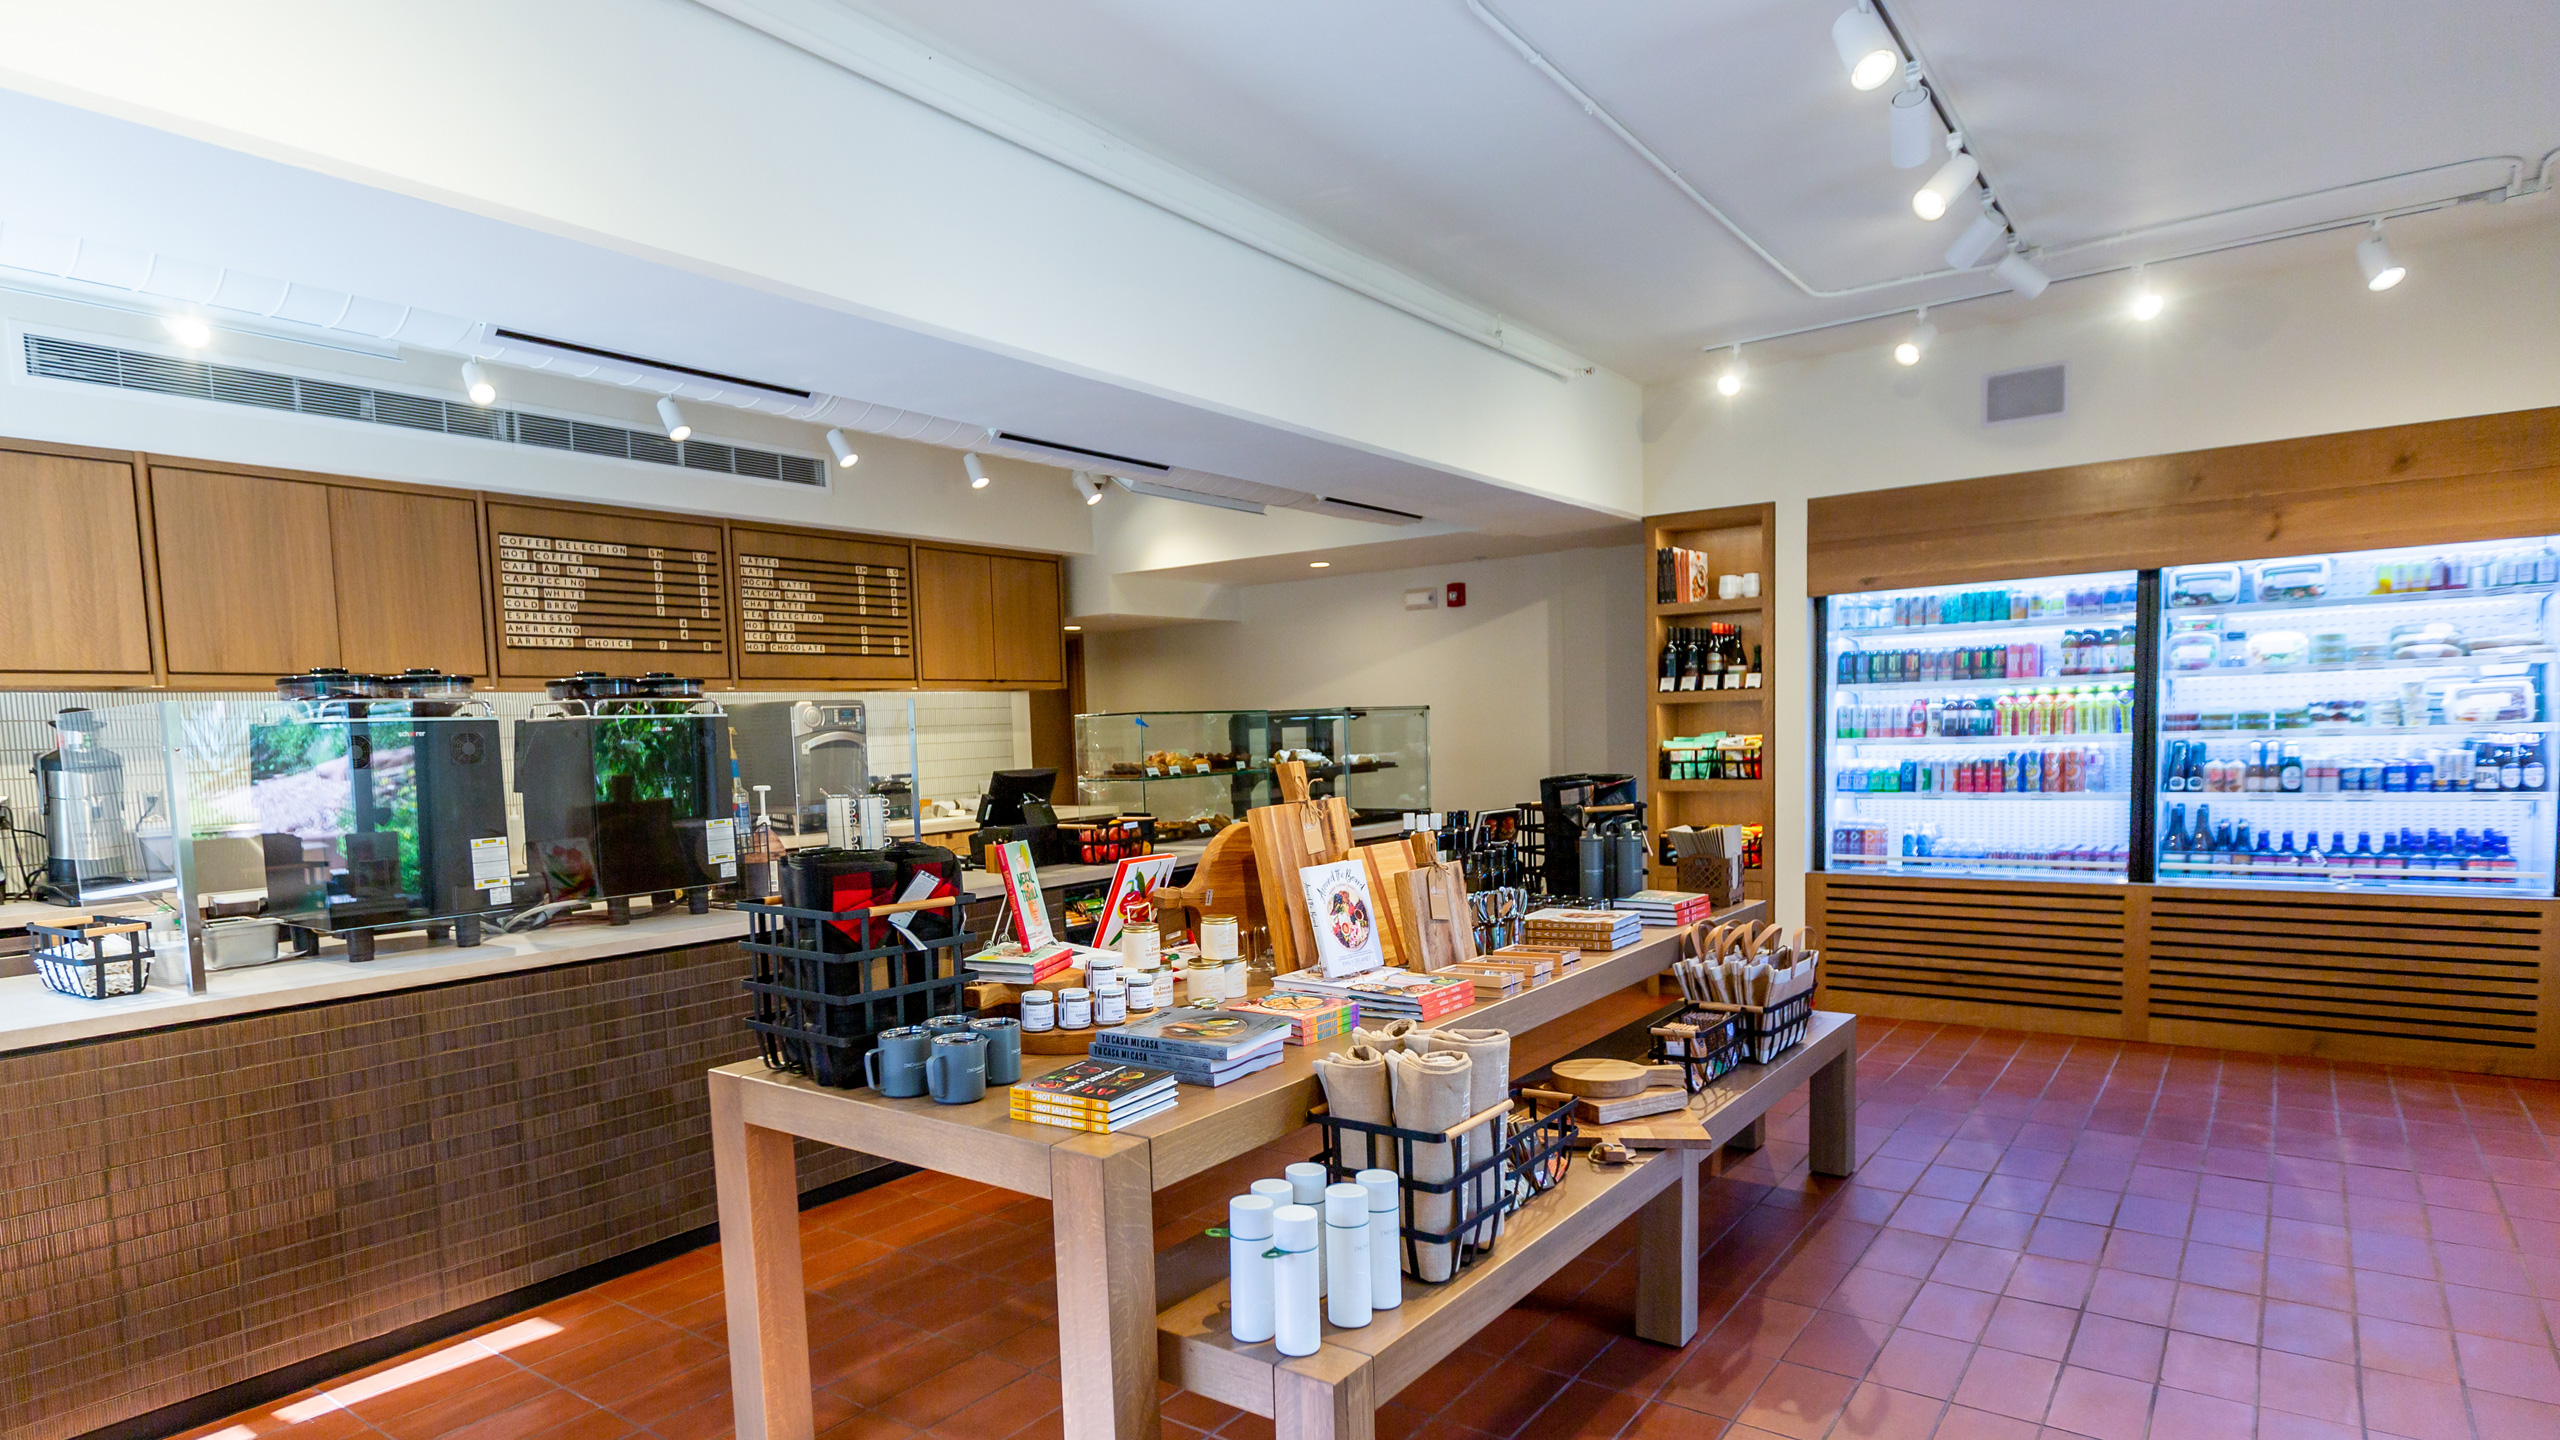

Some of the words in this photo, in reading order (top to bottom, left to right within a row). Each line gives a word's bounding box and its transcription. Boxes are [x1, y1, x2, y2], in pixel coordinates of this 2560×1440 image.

[501, 536, 550, 548] COFFEE
[557, 541, 627, 555] SELECTION
[693, 553, 707, 561] LG
[502, 549, 526, 558] HOT
[534, 552, 581, 563] COFFEE
[741, 557, 778, 566] LATTES
[503, 562, 535, 571] CAFE
[568, 566, 598, 576] LAIT
[742, 567, 772, 576] LATTE
[504, 575, 585, 586] CAPPUCCINO
[657, 584, 662, 592] 7
[742, 579, 774, 587] MOCHA
[780, 581, 809, 589] LATTE
[505, 587, 537, 596] FLAT
[544, 589, 583, 598] WHITE
[742, 589, 781, 598] MATCHA
[786, 592, 814, 600] LATTE
[506, 599, 538, 609] COLD
[546, 601, 577, 610] BREW
[659, 607, 664, 615] 7
[743, 600, 767, 608] CHAI
[775, 602, 803, 610] LATTE
[507, 612, 571, 622] ESPRESSO
[770, 612, 823, 621] SELECTION
[507, 623, 580, 634] AMERICANO
[771, 623, 793, 631] TEAS
[747, 632, 770, 640] ICED
[508, 637, 573, 646] BARISTAS
[587, 639, 631, 647] CHOICE
[661, 641, 666, 649] 7
[771, 644, 824, 652] CHOCOLATE
[1101, 1034, 1110, 1043] TU
[1111, 1035, 1129, 1046] CASA
[1130, 1038, 1139, 1047] MI
[1140, 1039, 1159, 1050] CASA
[1094, 1046, 1102, 1055] TU
[1103, 1047, 1119, 1058] CASA
[1121, 1050, 1130, 1059] MI
[1130, 1051, 1147, 1062] CASA
[1036, 1093, 1051, 1101] HOT
[1051, 1095, 1072, 1105] SAUCE
[1036, 1104, 1051, 1112] HOT
[1051, 1106, 1072, 1116] SAUCE
[1036, 1115, 1051, 1124] HOT
[1051, 1117, 1072, 1128] SAUCE
